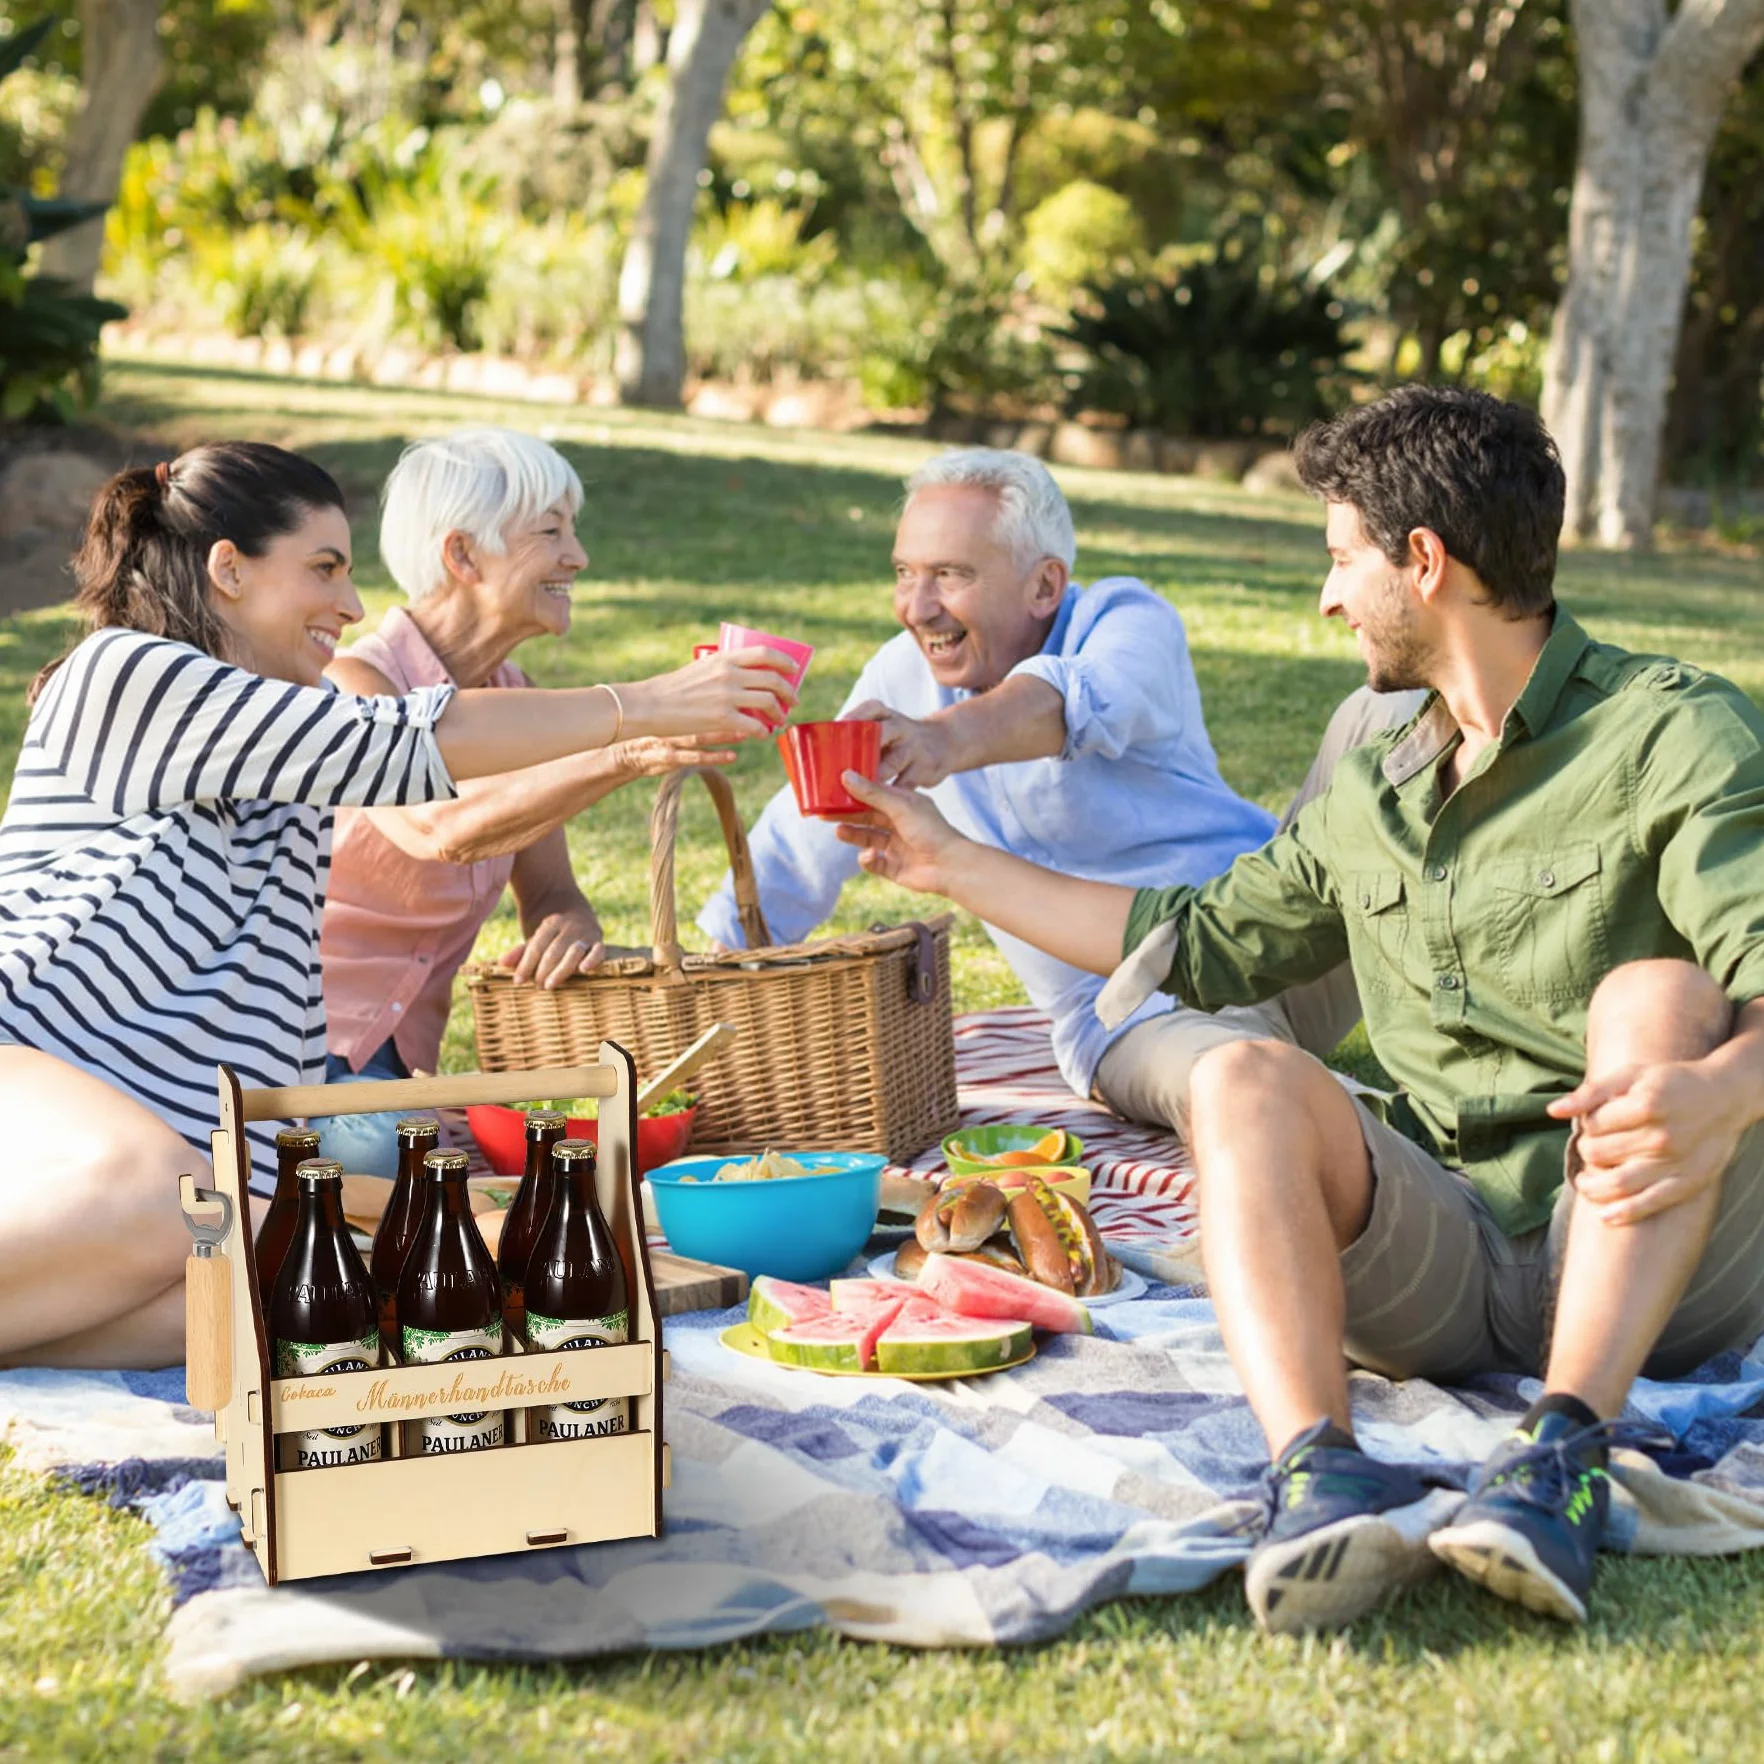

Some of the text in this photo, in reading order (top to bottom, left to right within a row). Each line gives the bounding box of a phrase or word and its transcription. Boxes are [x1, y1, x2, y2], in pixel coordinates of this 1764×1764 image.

[356, 1361, 571, 1412] Männerhandtasche
[421, 1424, 504, 1453] PAULANER
[540, 1415, 625, 1438] PAULANER
[297, 1436, 381, 1467] PAULANER
